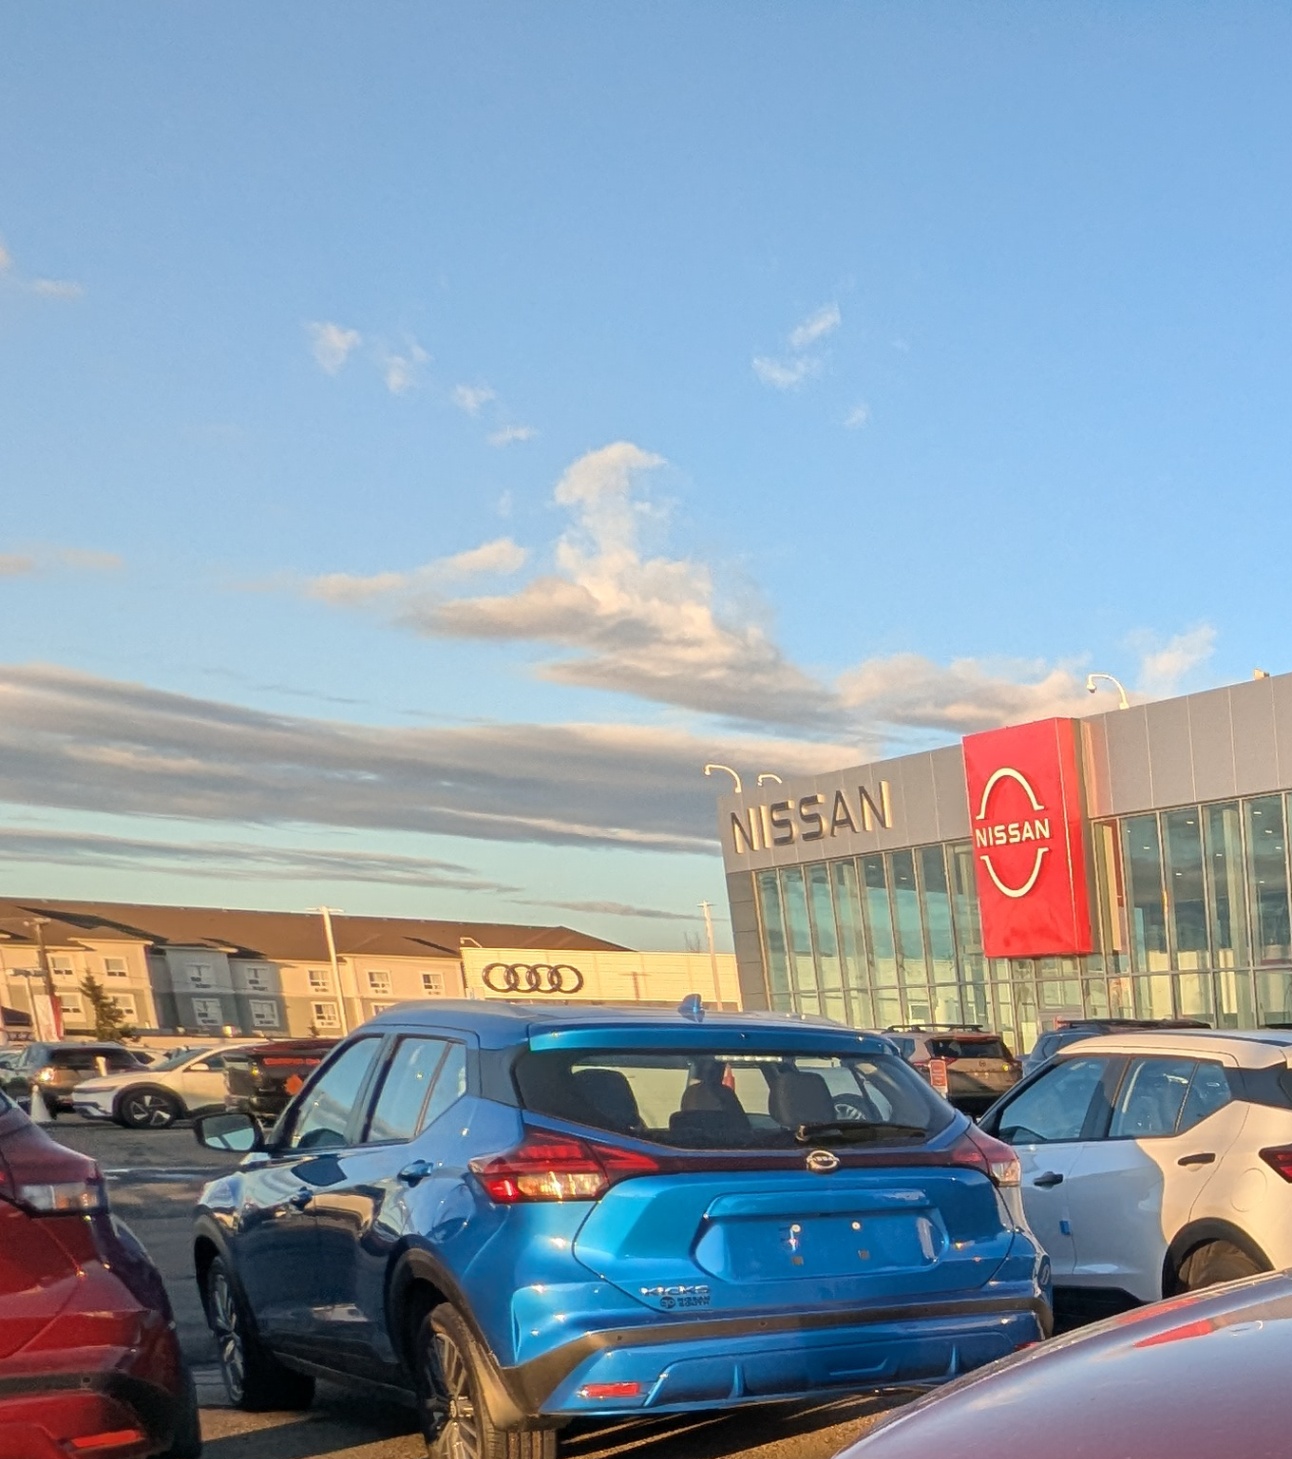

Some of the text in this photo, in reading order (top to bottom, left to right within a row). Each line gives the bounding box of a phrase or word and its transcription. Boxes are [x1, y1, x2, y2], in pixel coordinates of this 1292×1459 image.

[731, 780, 893, 854] NISSAN
[976, 817, 1050, 847] NISSAN
[640, 1284, 710, 1296] KICKS
